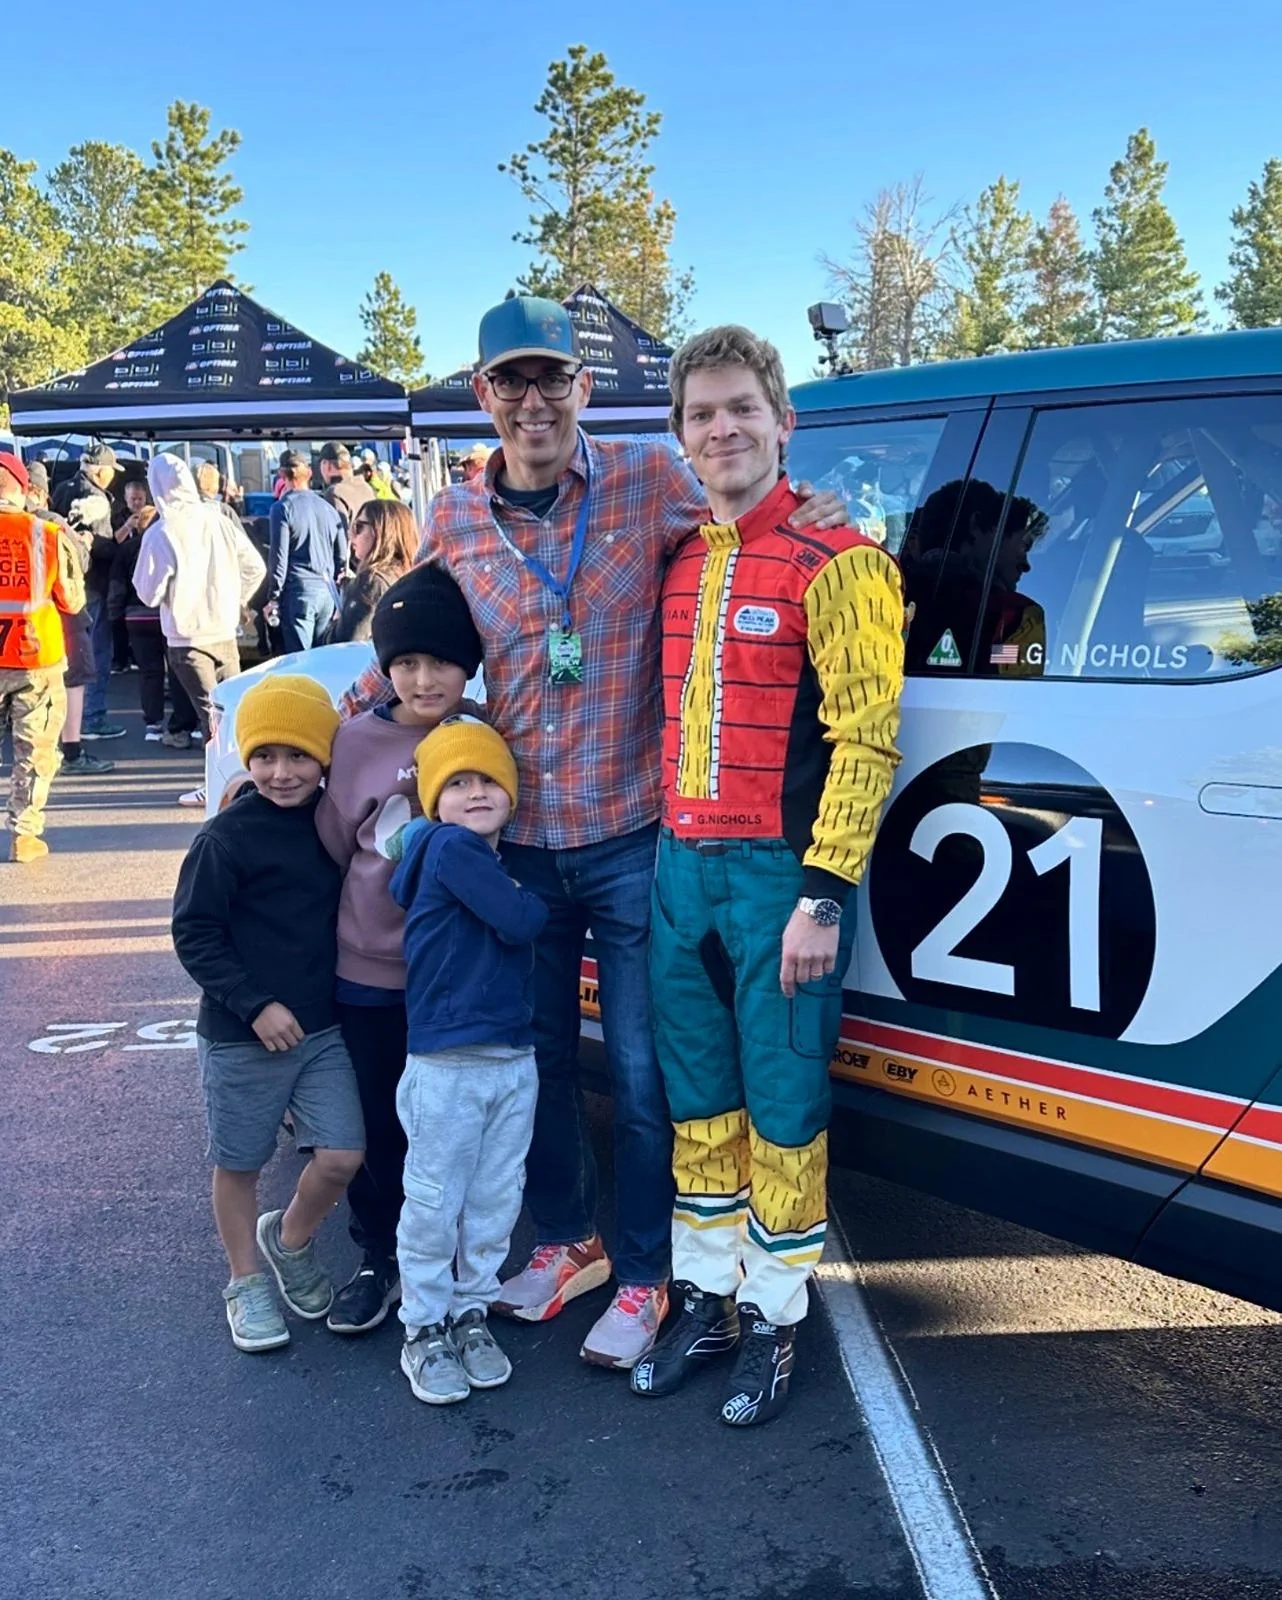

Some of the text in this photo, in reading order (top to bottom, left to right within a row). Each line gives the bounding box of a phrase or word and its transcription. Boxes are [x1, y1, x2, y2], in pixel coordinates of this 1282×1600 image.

[202, 323, 241, 333] OPTIMA
[275, 341, 312, 351] OPTIMA
[199, 359, 239, 369] OPTIMA
[273, 377, 312, 386] OPTIMA
[1061, 643, 1188, 669] NICHOLS
[696, 813, 763, 826] G.NICHOLS
[908, 801, 1103, 1013] 21
[886, 1063, 918, 1080] EBY
[967, 1083, 1068, 1121] AETHER
[752, 1322, 777, 1335] OMP
[637, 1362, 651, 1391] OMP
[723, 1394, 751, 1420] OMP
